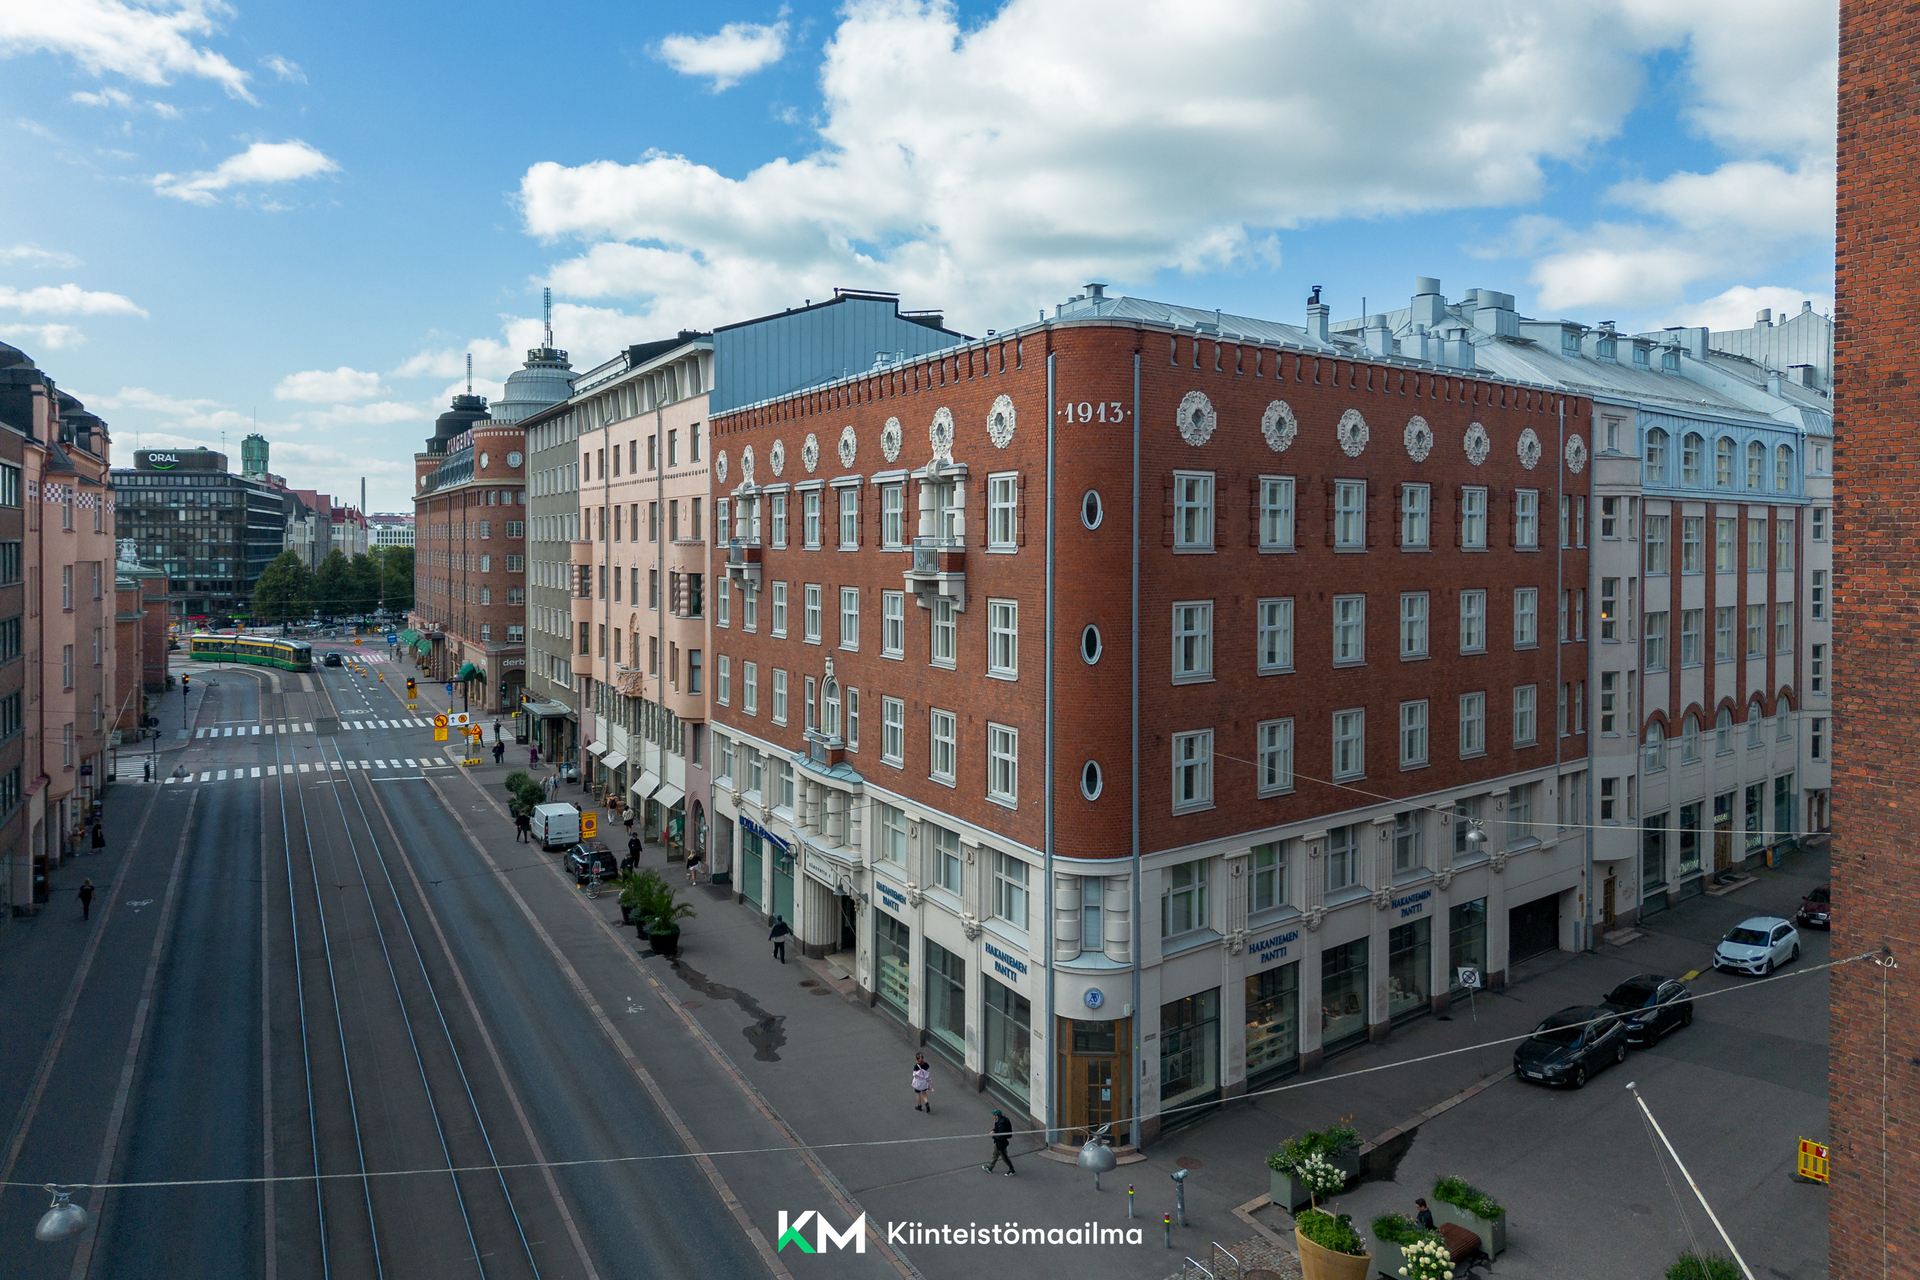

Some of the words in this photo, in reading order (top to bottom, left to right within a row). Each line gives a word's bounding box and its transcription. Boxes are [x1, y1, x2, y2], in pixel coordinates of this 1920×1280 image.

[1064, 402, 1124, 423] 1913
[148, 453, 180, 462] ORAL
[875, 880, 907, 905] HAKANIEMEN
[1391, 889, 1432, 910] HAKANIEMEN
[882, 895, 900, 913] PANTTI
[1401, 903, 1423, 918] PANTTI
[1248, 930, 1299, 955] HAKANIEMEN
[985, 941, 1027, 975] HAKANIEMEN
[1261, 946, 1287, 964] PANTTI
[994, 960, 1017, 983] PANTTI
